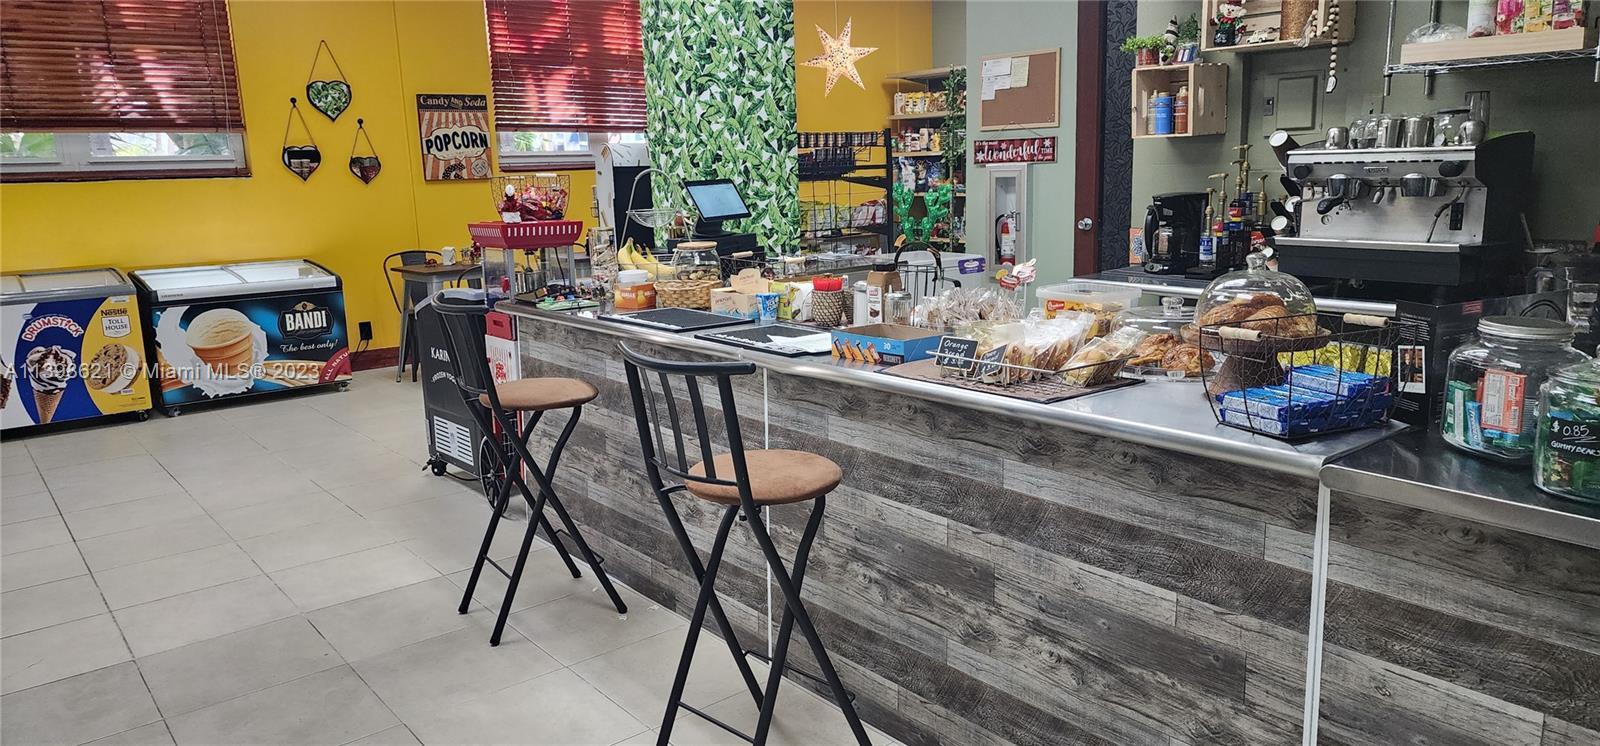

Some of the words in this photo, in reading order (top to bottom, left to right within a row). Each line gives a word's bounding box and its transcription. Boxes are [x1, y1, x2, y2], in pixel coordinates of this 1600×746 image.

[420, 95, 449, 107] Candy
[464, 97, 486, 106] Soda
[425, 131, 488, 154] POPCORN
[984, 139, 1041, 161] Wonderful
[23, 317, 83, 341] DRUMSTICK
[285, 311, 327, 331] BANDI
[280, 344, 299, 353] The
[300, 342, 315, 351] best
[316, 339, 338, 350] only!
[944, 340, 969, 352] Orange
[324, 368, 334, 381] ALL
[332, 351, 350, 367] NATU
[1562, 425, 1590, 437] 0.85
[1551, 441, 1576, 452] GUMMY
